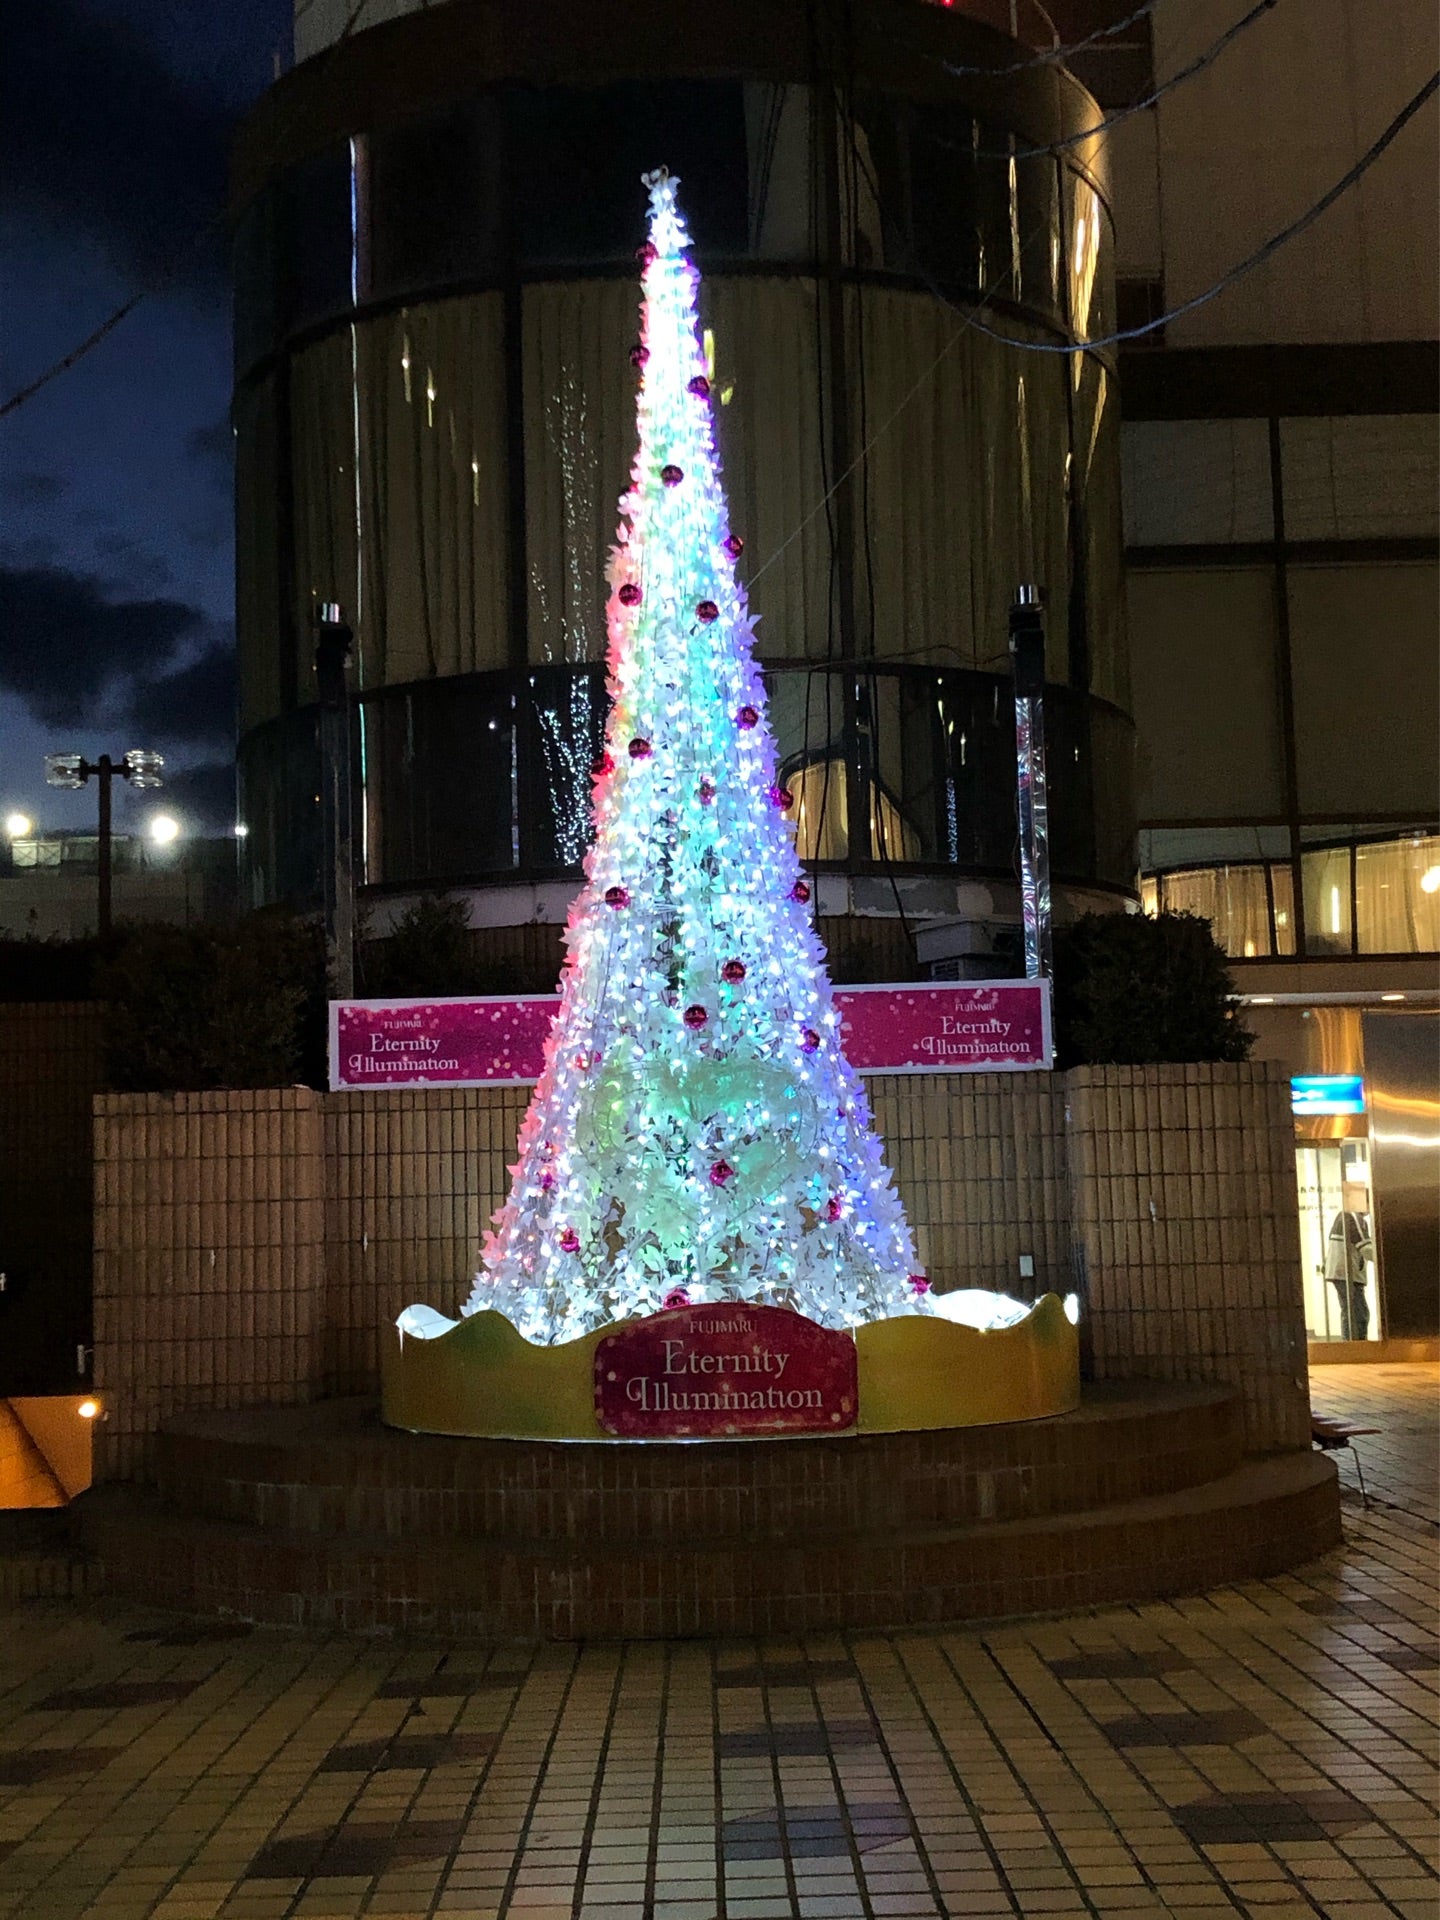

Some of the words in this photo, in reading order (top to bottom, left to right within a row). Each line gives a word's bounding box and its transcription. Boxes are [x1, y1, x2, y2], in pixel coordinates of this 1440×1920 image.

[940, 1016, 1011, 1036] Eternity
[369, 1033, 441, 1053] Eternity
[920, 1036, 1031, 1055] Illumination
[348, 1054, 459, 1073] Illumination
[689, 1319, 758, 1335] FUJIMARU
[660, 1340, 789, 1379] Eternity
[626, 1376, 823, 1412] Illumination
